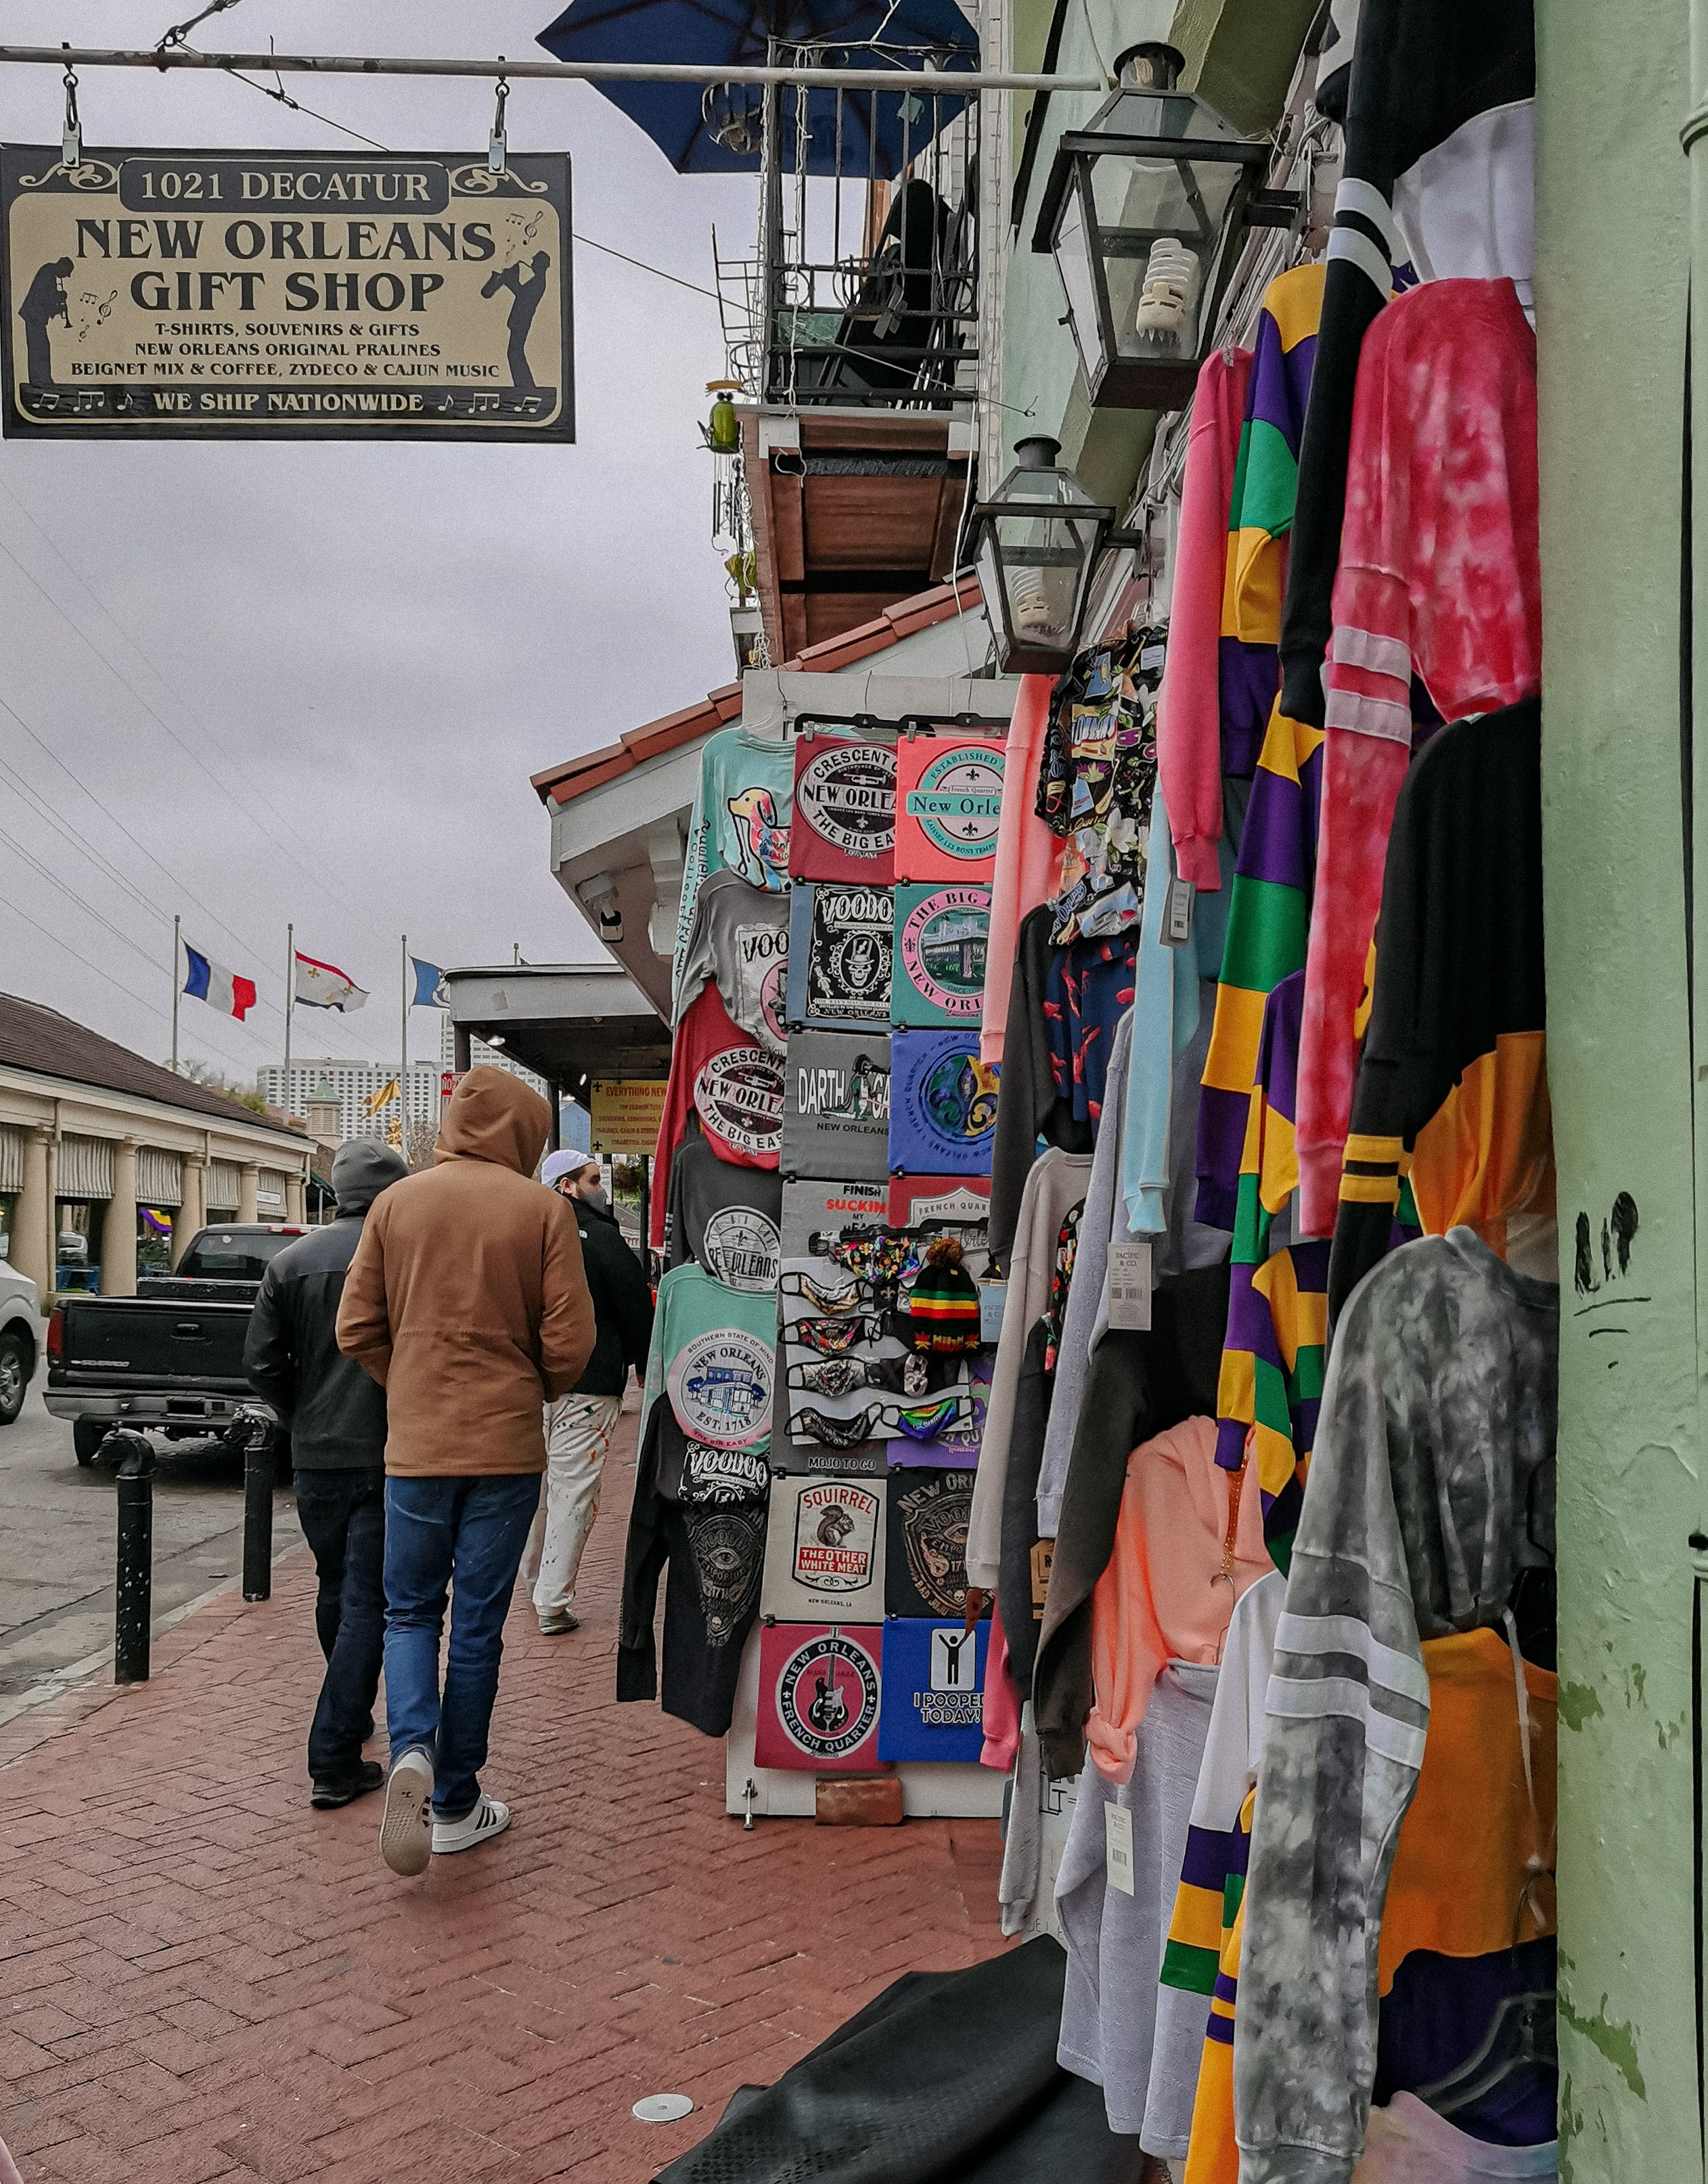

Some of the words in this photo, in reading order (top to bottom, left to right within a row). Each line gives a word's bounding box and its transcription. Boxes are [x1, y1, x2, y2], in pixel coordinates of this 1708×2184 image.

[141, 172, 223, 199] 1021
[241, 172, 431, 201] DECATUR
[76, 219, 204, 258] NEW
[225, 220, 495, 260] ORLEANS
[131, 271, 265, 311] GIFT
[286, 272, 444, 311] SHOP
[155, 323, 239, 337] T-SHIRTS,
[245, 323, 343, 336] SOUVENIRS
[349, 324, 363, 336] &
[369, 324, 420, 336] GIFTS
[135, 343, 173, 355] NEW
[179, 343, 260, 356] ORLEANS
[265, 344, 350, 356] ORIGINAL
[356, 344, 441, 357] PRALINES
[71, 363, 148, 376] BEIGNET
[154, 363, 184, 375] MIX
[190, 363, 204, 375] &
[210, 363, 282, 377] COFFEE,
[289, 364, 357, 376] ZYDECO
[363, 364, 378, 376] &
[384, 364, 439, 377] CAJUN
[447, 365, 499, 378] MUSIC
[153, 393, 193, 410] WE
[200, 393, 260, 411] SHIP
[267, 394, 424, 411] NATIONWIDE
[813, 749, 890, 778] CRESCENT
[930, 752, 998, 779] ESTABLISHED
[803, 784, 840, 803] NEW
[914, 796, 951, 812] New
[813, 810, 839, 838] THE
[842, 832, 869, 848] BIG
[874, 833, 896, 848] EA
[909, 898, 939, 930] THE
[946, 892, 978, 905] BIG
[907, 960, 939, 998] NEW
[711, 1050, 784, 1074] CRESCENT
[698, 1077, 732, 1097] NEW
[798, 1067, 845, 1115] DARTH
[704, 1104, 725, 1133] THE
[727, 1127, 750, 1145] BIG
[842, 1124, 890, 1137] ORLEANS
[843, 1185, 881, 1197] FINISH
[852, 1212, 865, 1221] MY
[919, 1202, 956, 1215] FRENCH
[688, 1332, 725, 1353] SOUTHERN
[727, 1333, 748, 1342] STATE
[750, 1340, 760, 1348] OF
[760, 1346, 773, 1364] MIND
[692, 1350, 717, 1373] NEW
[720, 1348, 766, 1380] ORLEANS
[696, 1411, 721, 1430] EST.
[725, 1416, 752, 1431] 1718
[694, 1429, 708, 1441] THE
[726, 1438, 748, 1447] EASY
[690, 1450, 768, 1488] VOODOO
[809, 1457, 840, 1469] MOJO
[842, 1458, 857, 1470] TO
[860, 1458, 876, 1470] GO
[803, 1488, 874, 1514] SQUIRREL
[896, 1480, 940, 1513] NEW
[801, 1560, 835, 1571] WHITE
[837, 1562, 866, 1574] MEAT
[802, 1549, 825, 1559] THE
[826, 1550, 867, 1564] OTHER
[785, 1651, 811, 1685] NEW
[817, 1641, 876, 1690] ORLEANS
[914, 1692, 920, 1707] I
[783, 1701, 819, 1749] FRENCH
[825, 1706, 874, 1752] QUARTER
[920, 1708, 981, 1723] TODAY!
